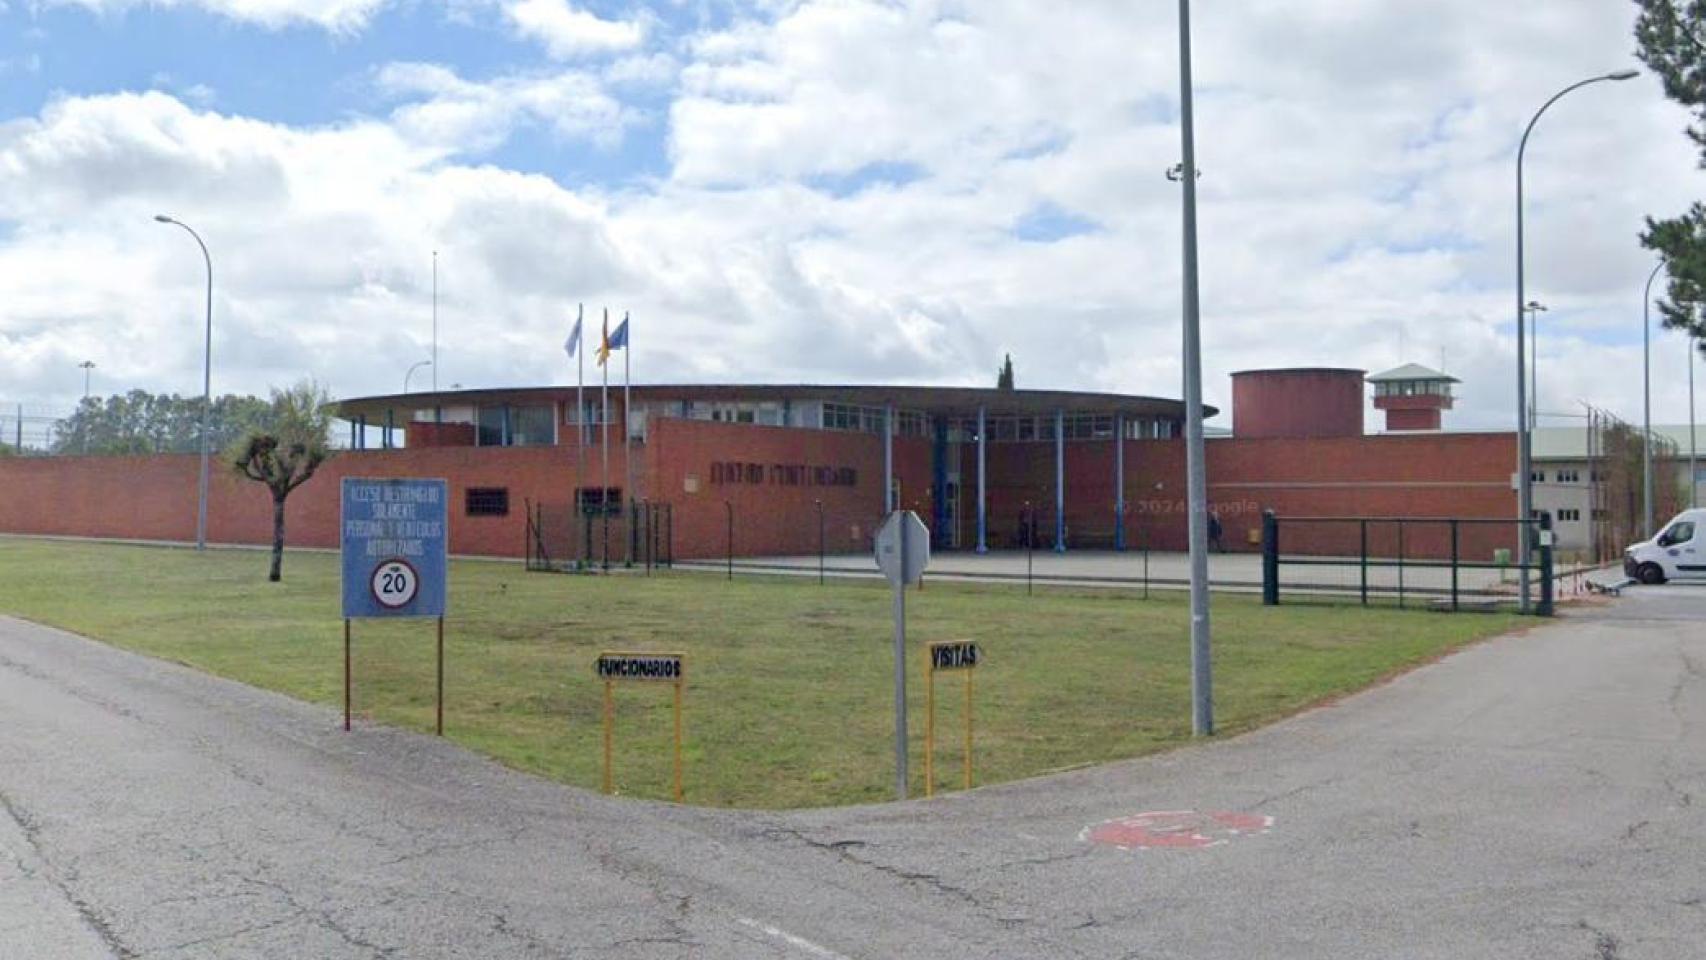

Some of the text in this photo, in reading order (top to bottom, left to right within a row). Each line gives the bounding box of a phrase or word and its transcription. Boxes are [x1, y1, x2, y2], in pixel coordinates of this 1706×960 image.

[382, 573, 406, 593] 20
[931, 644, 976, 668] VISITAS
[598, 657, 681, 677] FUNCIONARIOS
